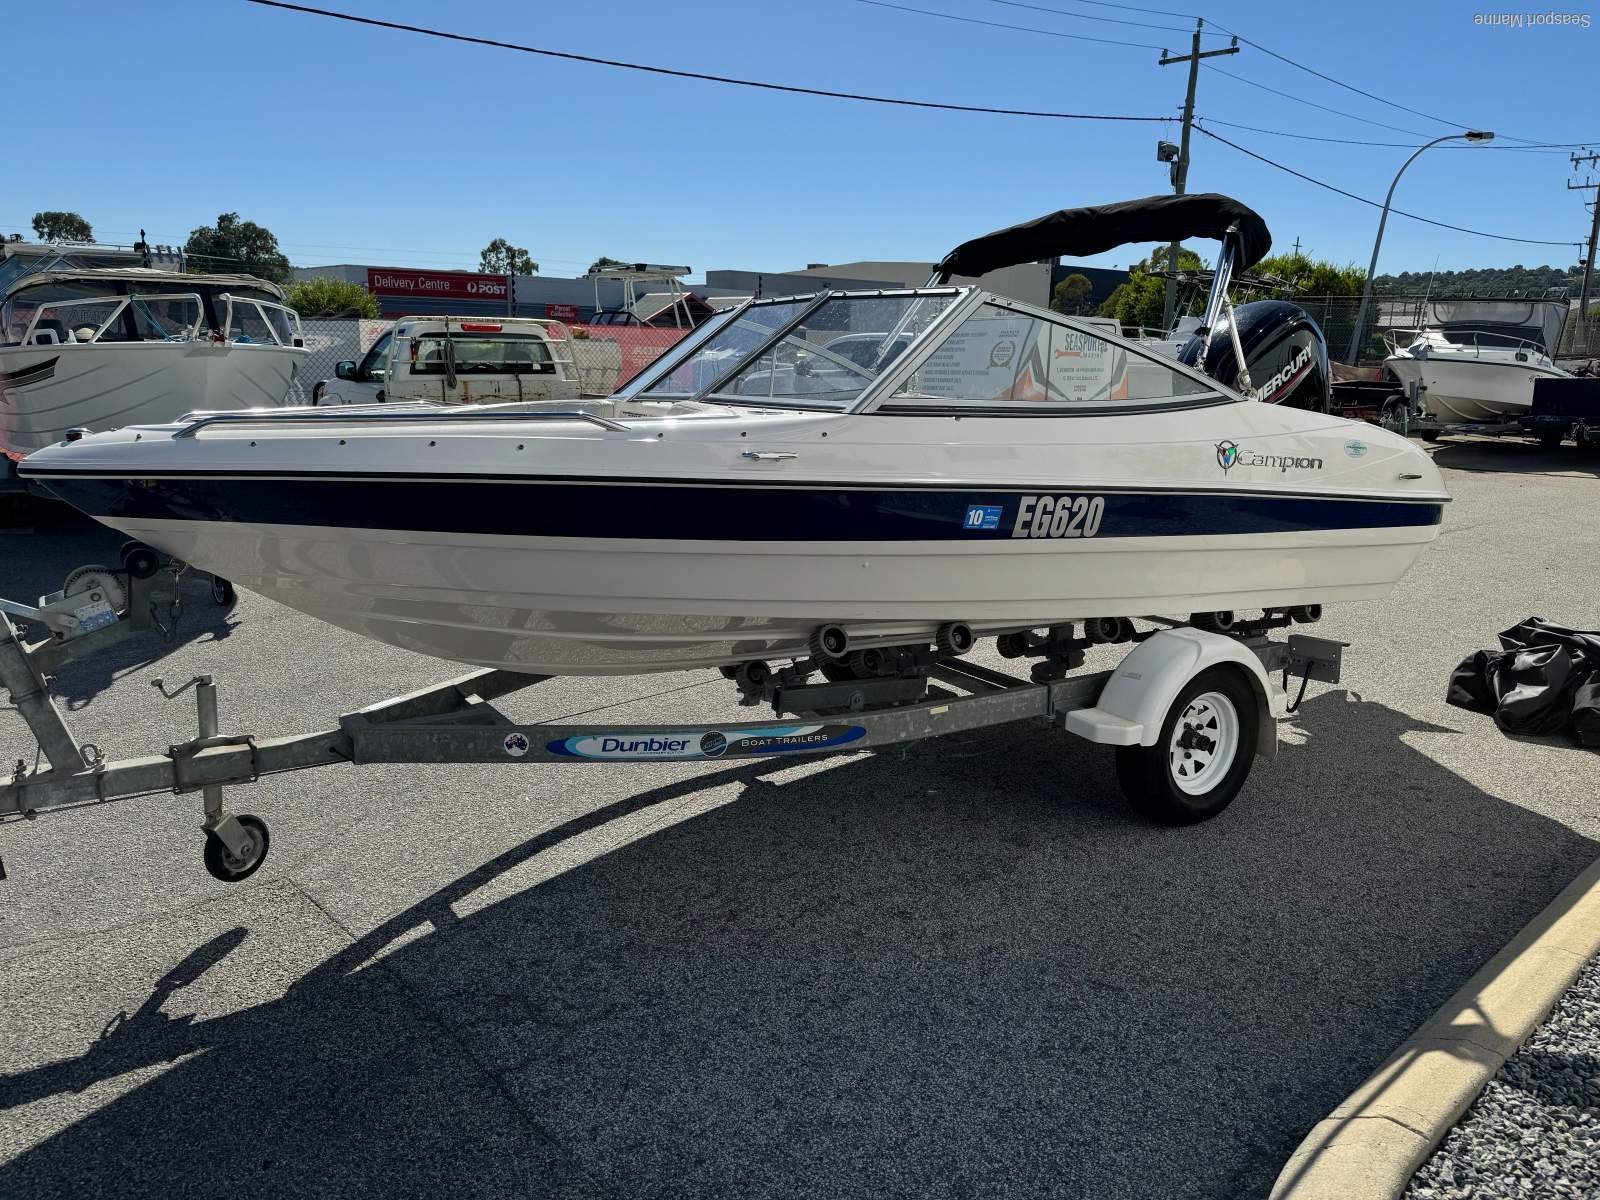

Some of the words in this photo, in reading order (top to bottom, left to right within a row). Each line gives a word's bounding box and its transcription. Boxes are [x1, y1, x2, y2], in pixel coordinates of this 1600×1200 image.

[374, 275, 415, 291] Delivery
[418, 277, 450, 291] Centre
[478, 284, 506, 295] POST
[1257, 340, 1312, 402] MERCURY
[1237, 449, 1323, 472] Campion
[968, 509, 984, 525] 10
[1012, 495, 1105, 538] EG620
[601, 737, 690, 753] Dunbier
